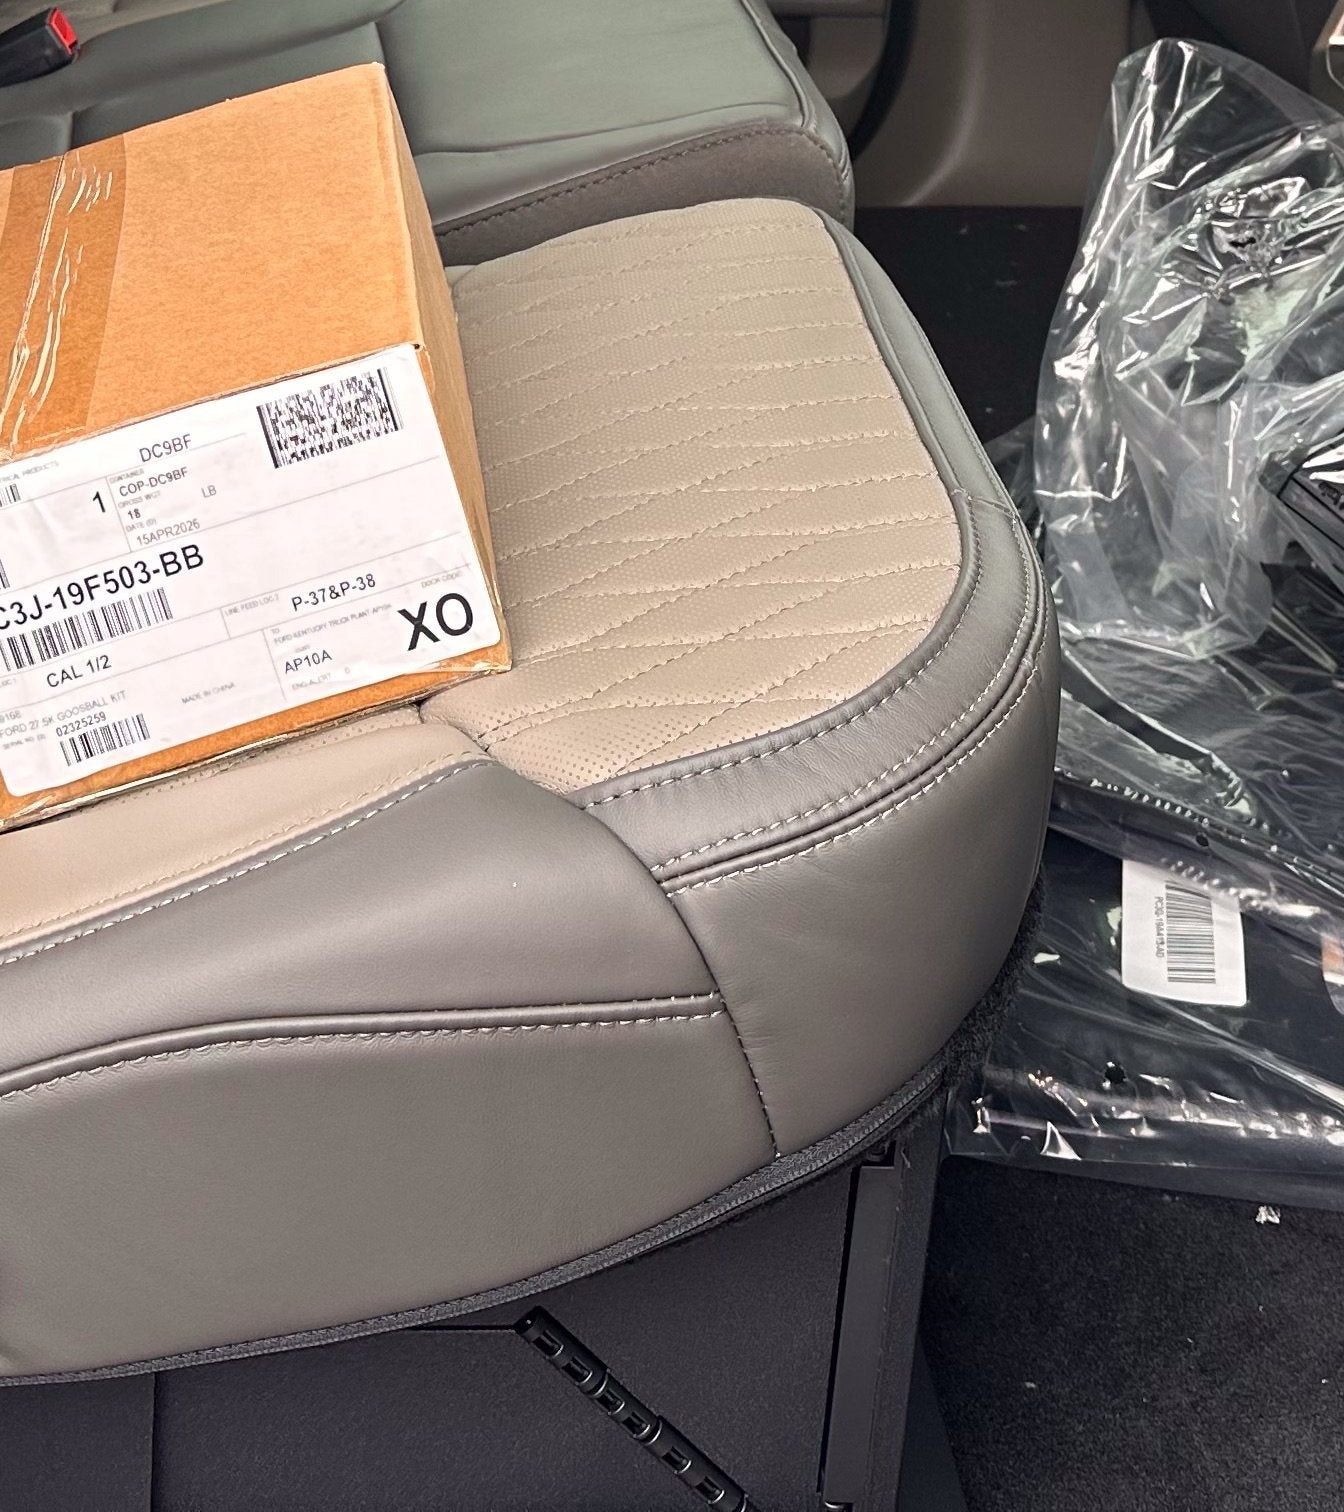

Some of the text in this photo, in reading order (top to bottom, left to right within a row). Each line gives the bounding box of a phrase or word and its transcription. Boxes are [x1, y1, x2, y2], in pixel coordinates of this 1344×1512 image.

[139, 434, 192, 462] DC9BF
[119, 467, 188, 497] COP-DC9BF
[201, 485, 217, 498] LB
[93, 491, 106, 513] 1
[136, 518, 200, 547] 15APR2026
[291, 573, 376, 612] P-37&P-38
[397, 592, 474, 651] XO
[46, 654, 113, 688] CAL 1/2
[284, 649, 333, 674] AP10A
[109, 690, 127, 705] KIT
[56, 711, 107, 738] 02325259
